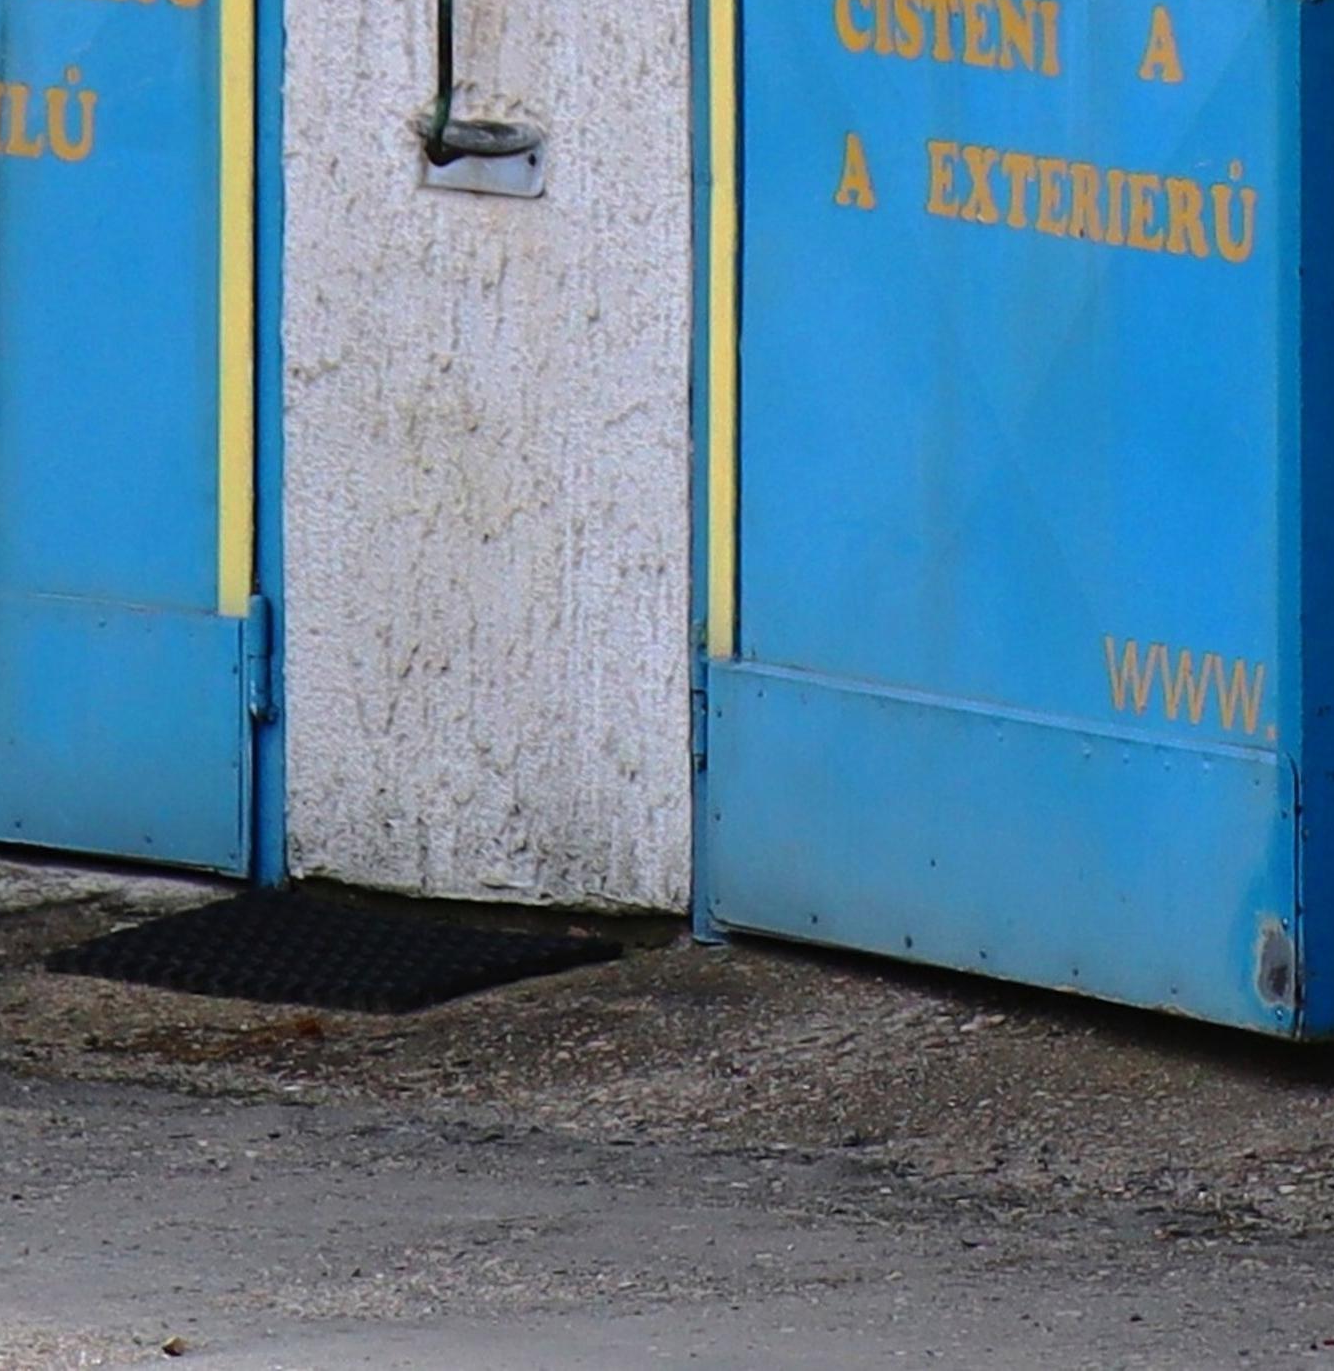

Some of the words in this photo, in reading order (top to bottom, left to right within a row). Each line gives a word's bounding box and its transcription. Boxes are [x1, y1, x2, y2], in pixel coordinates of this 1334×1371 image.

[1139, 4, 1184, 83] A
[834, 132, 877, 210] A
[926, 139, 1257, 263] EXTERIERŮ
